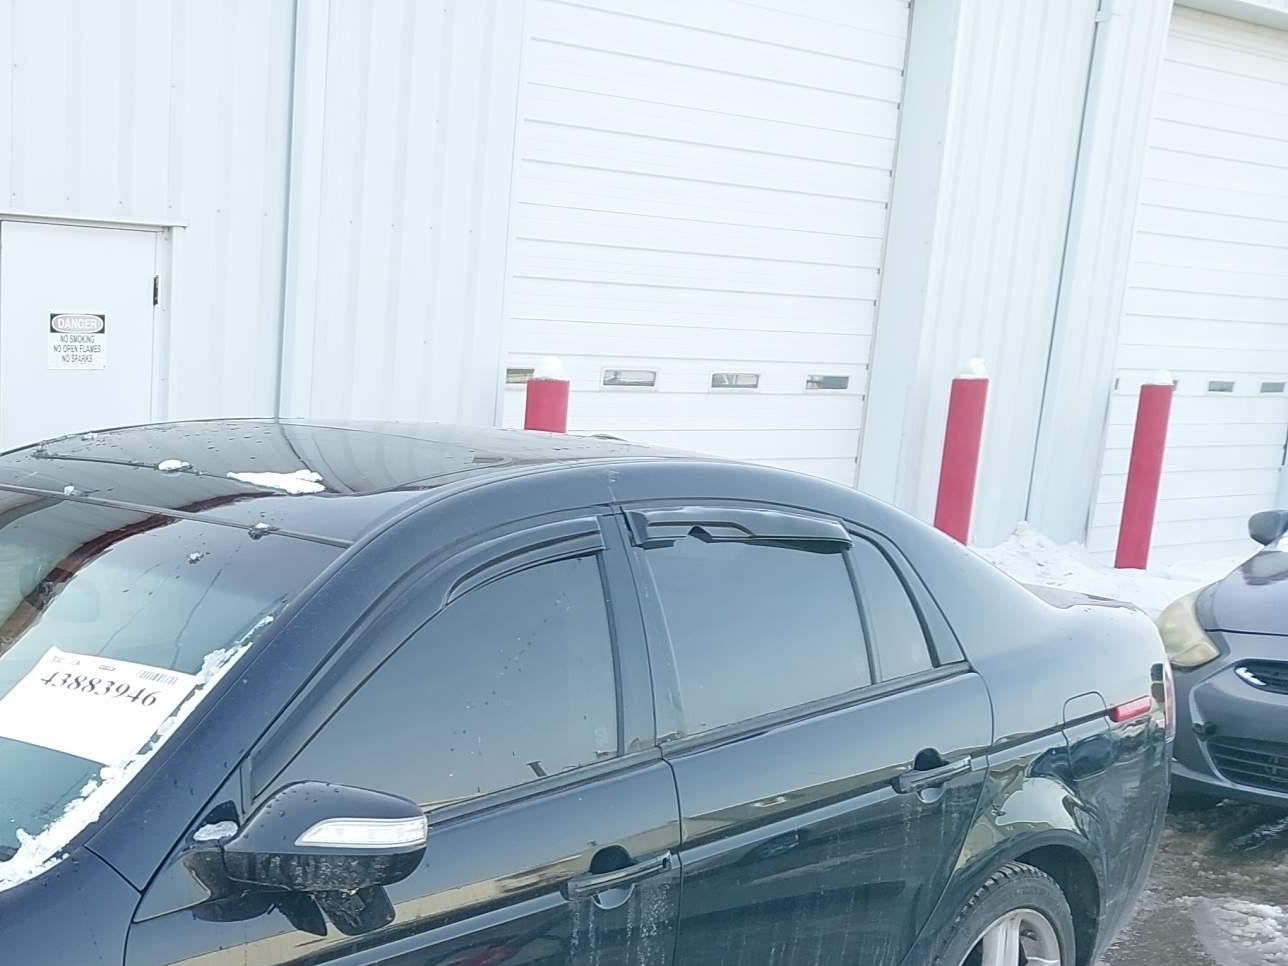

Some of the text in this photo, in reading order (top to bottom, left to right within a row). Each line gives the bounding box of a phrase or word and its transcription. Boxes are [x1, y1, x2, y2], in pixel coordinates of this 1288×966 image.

[57, 318, 97, 329] DANGER
[60, 334, 95, 343] NO SMOKING
[53, 344, 101, 353] NO OPEN FLAMES
[61, 354, 93, 363] NO SPARKS
[40, 671, 158, 707] 43883946
